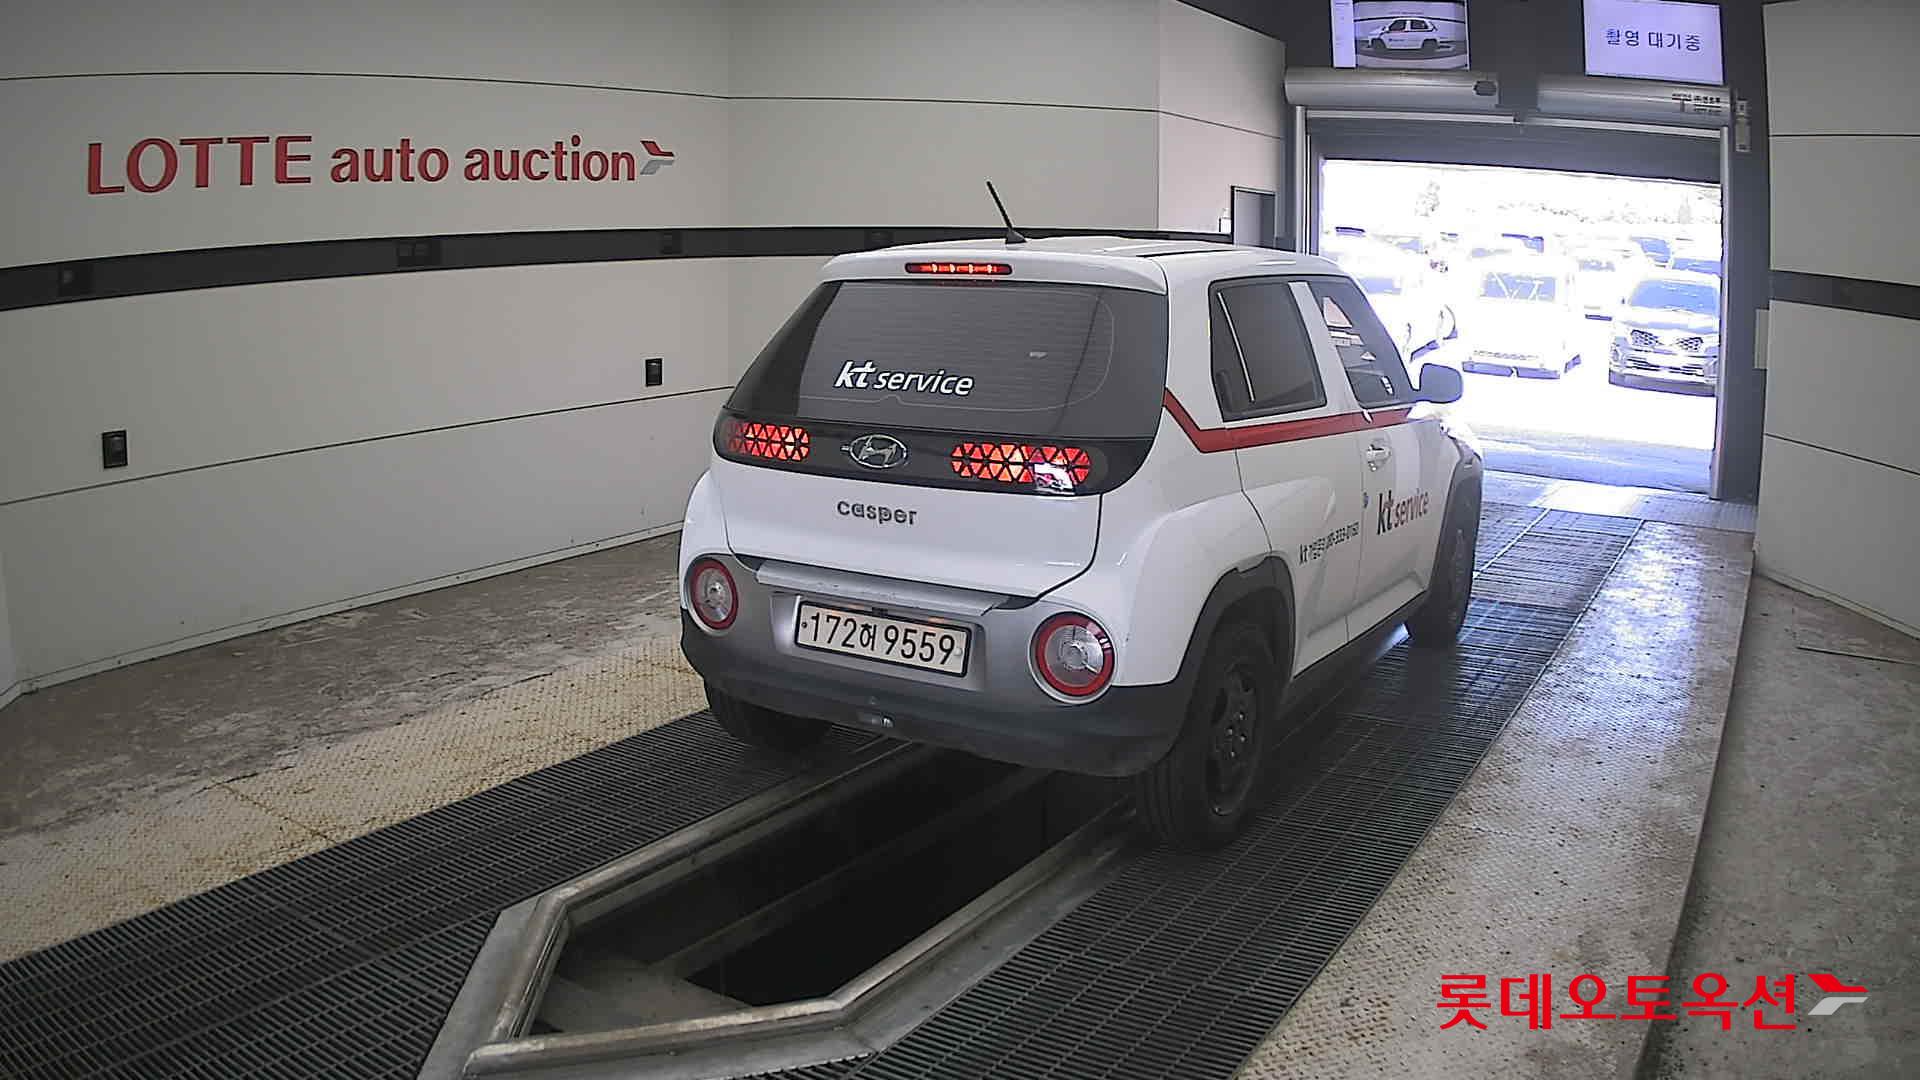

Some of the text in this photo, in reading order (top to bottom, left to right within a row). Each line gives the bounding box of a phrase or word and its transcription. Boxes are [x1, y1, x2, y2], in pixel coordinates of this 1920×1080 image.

[87, 134, 637, 195] LOTTE auto auction
[833, 359, 975, 396] kt service
[836, 500, 919, 525] casper
[1376, 488, 1430, 536] kt service
[883, 624, 956, 665] 9559
